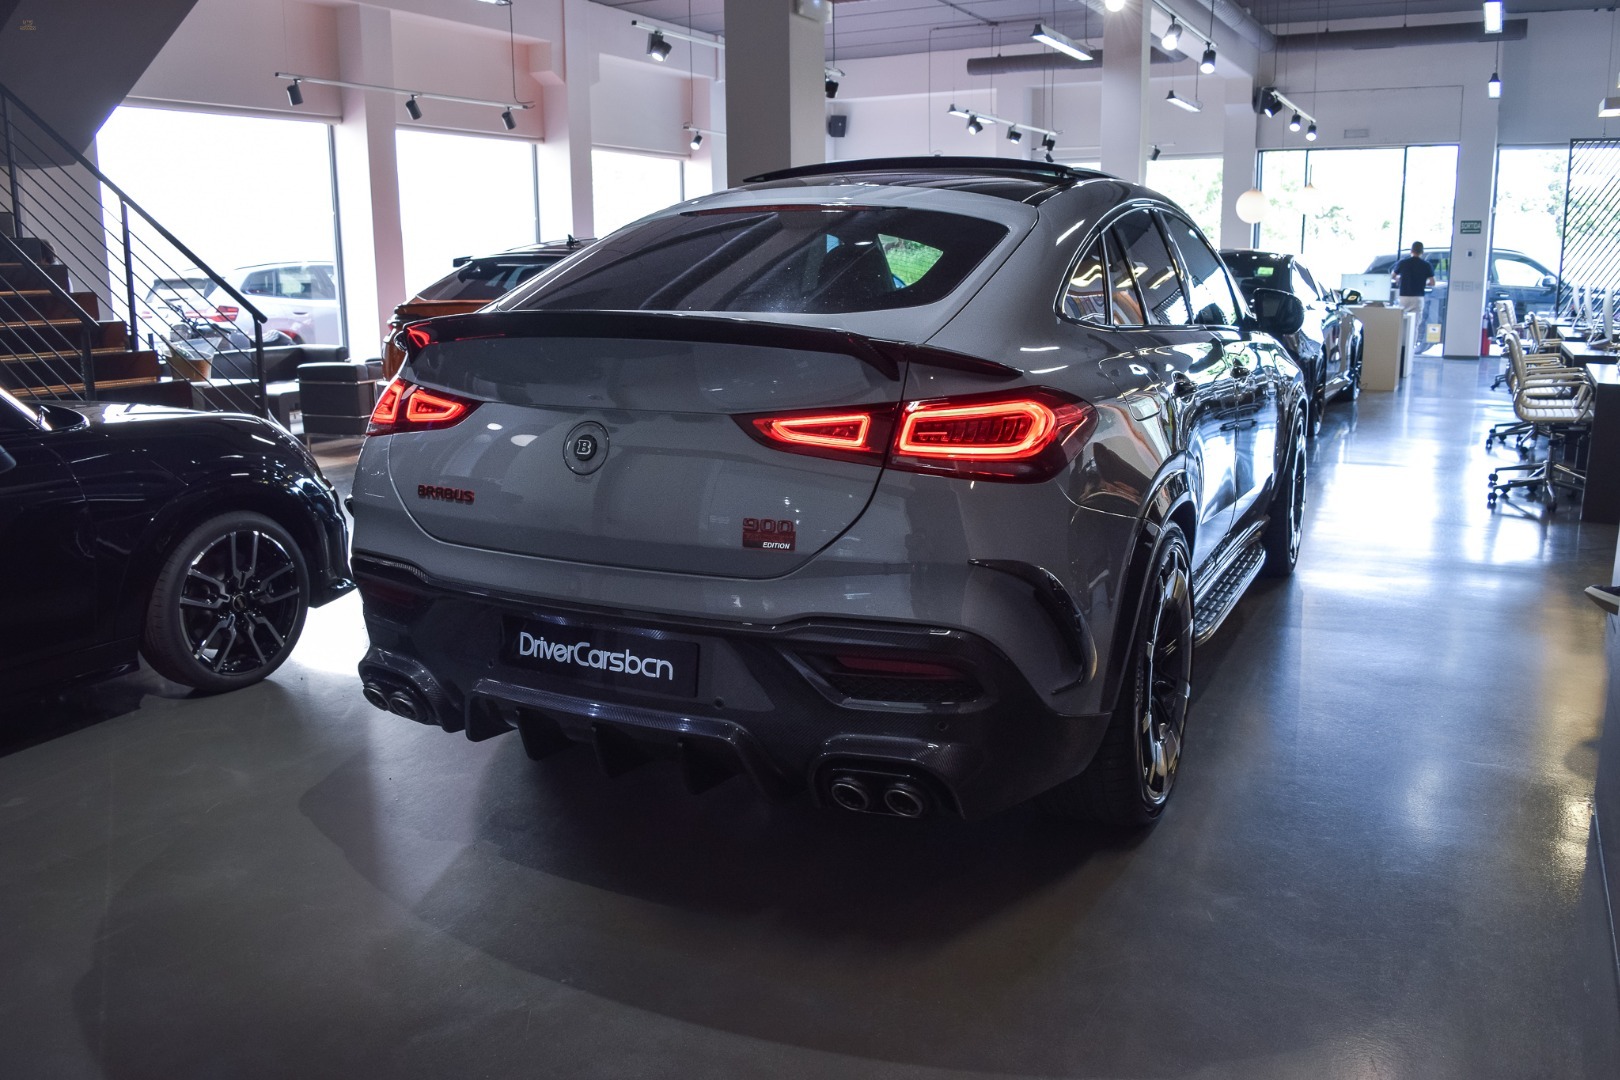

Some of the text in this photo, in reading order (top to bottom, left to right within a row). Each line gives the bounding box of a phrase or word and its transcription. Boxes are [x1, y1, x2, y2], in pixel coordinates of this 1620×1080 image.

[577, 439, 592, 455] B
[418, 484, 474, 503] BRABUS
[743, 518, 794, 533] 900
[762, 541, 791, 550] EDITION
[519, 631, 674, 680] DriverCarsbcn
